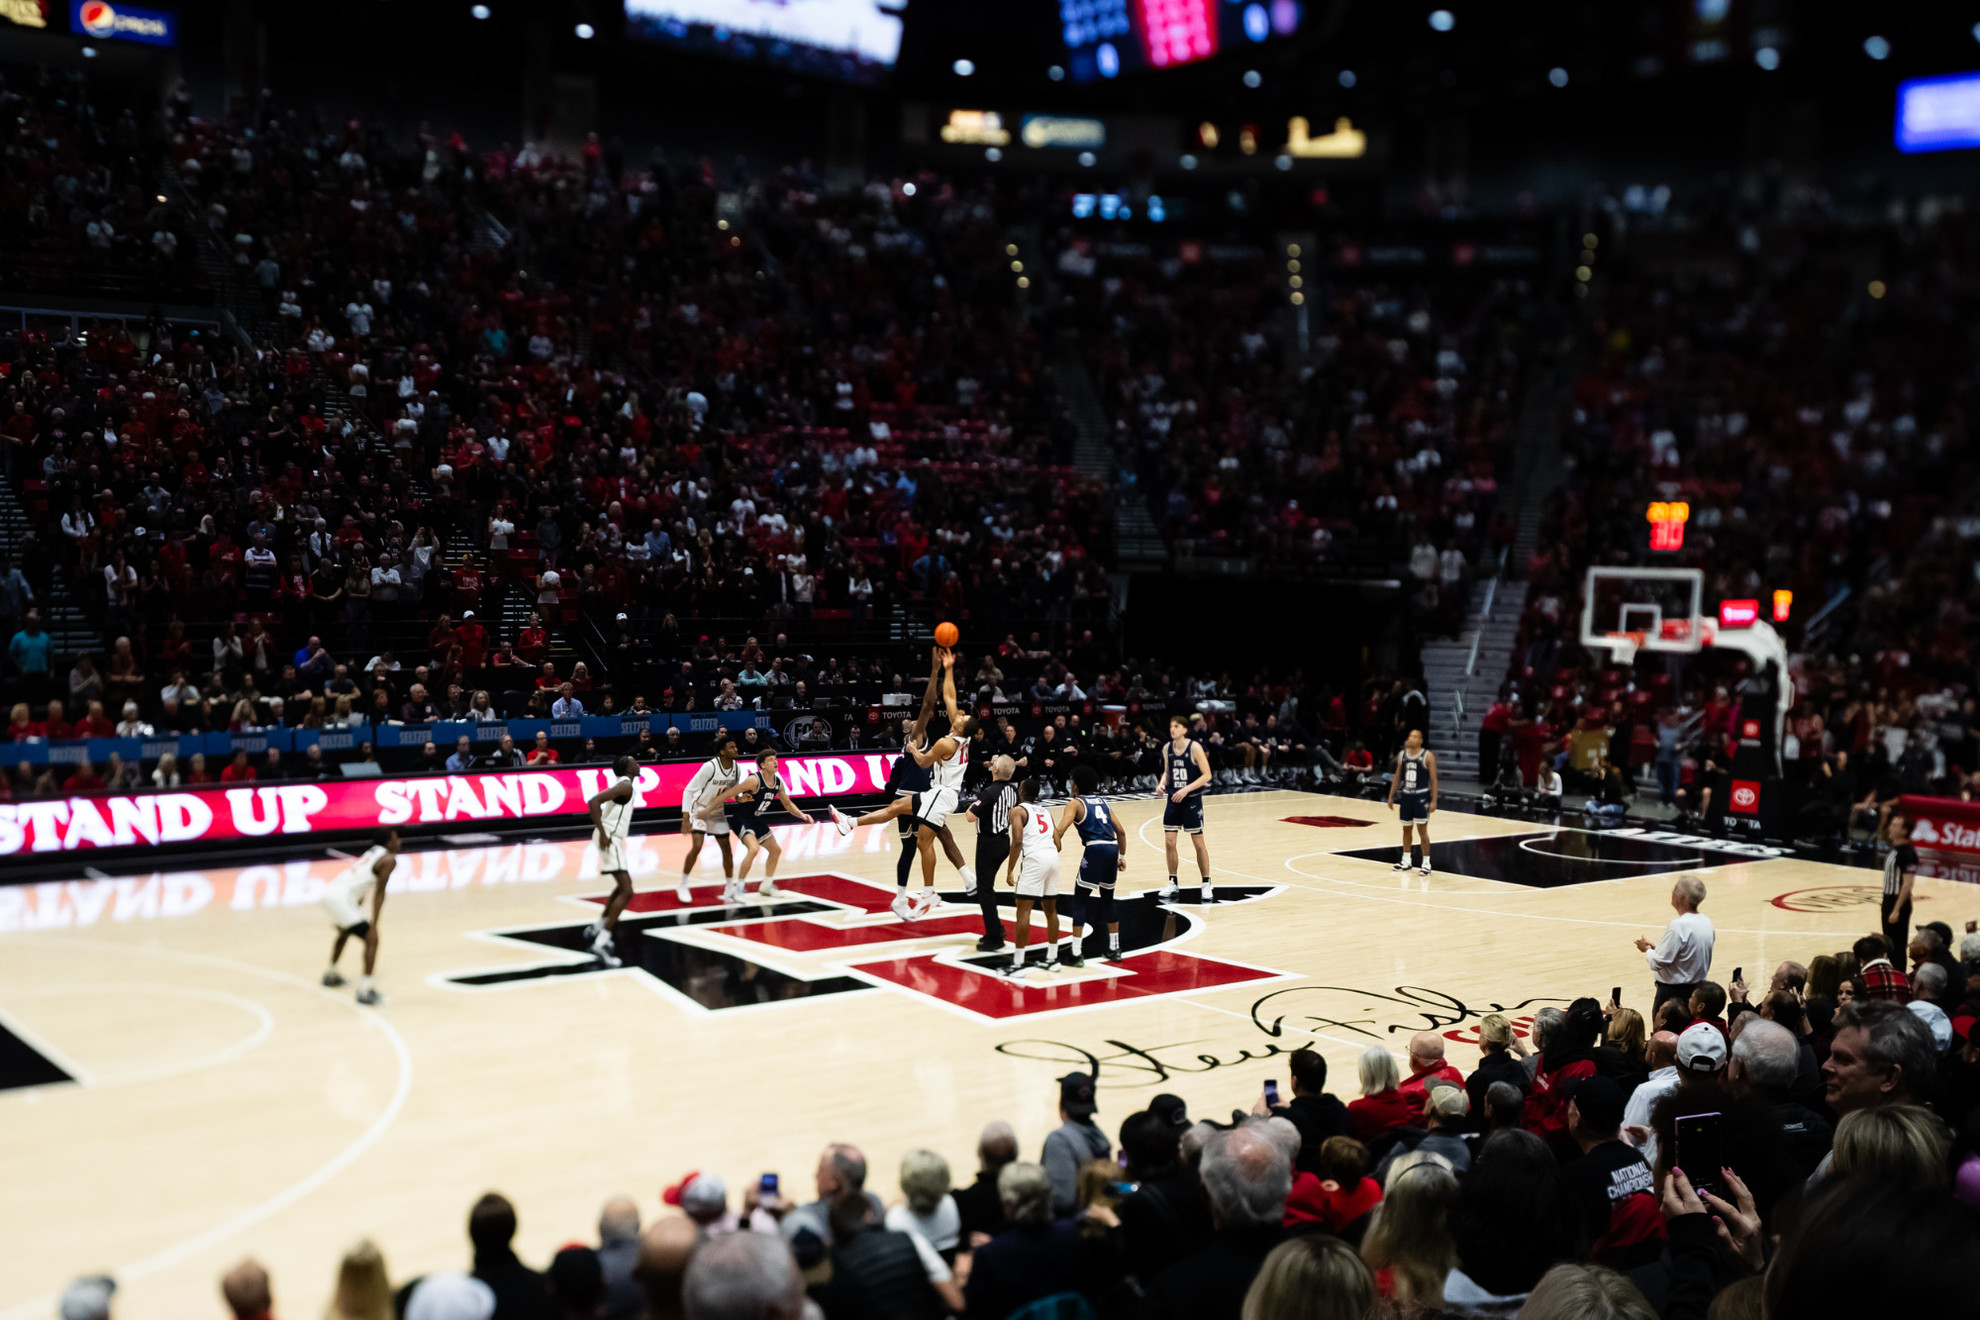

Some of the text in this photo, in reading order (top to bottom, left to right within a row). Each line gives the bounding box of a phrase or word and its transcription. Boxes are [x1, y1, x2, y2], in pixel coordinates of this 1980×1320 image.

[882, 711, 911, 720] TOYOTA
[993, 707, 1020, 716] TOYOTA
[550, 723, 581, 737] SELTZER
[620, 720, 650, 734] SELTZER
[690, 718, 718, 731] SELTZER
[400, 730, 432, 744] SELTZER
[476, 726, 508, 741] SELTZER
[1172, 768, 1188, 781] 20
[375, 772, 566, 824] STAND
[757, 801, 771, 812] 12
[0, 785, 328, 854] STAND UP
[1095, 805, 1108, 824] 4
[1036, 814, 1048, 834] 5
[1723, 816, 1762, 830] TOTA
[1610, 1161, 1649, 1185] NATIONAL
